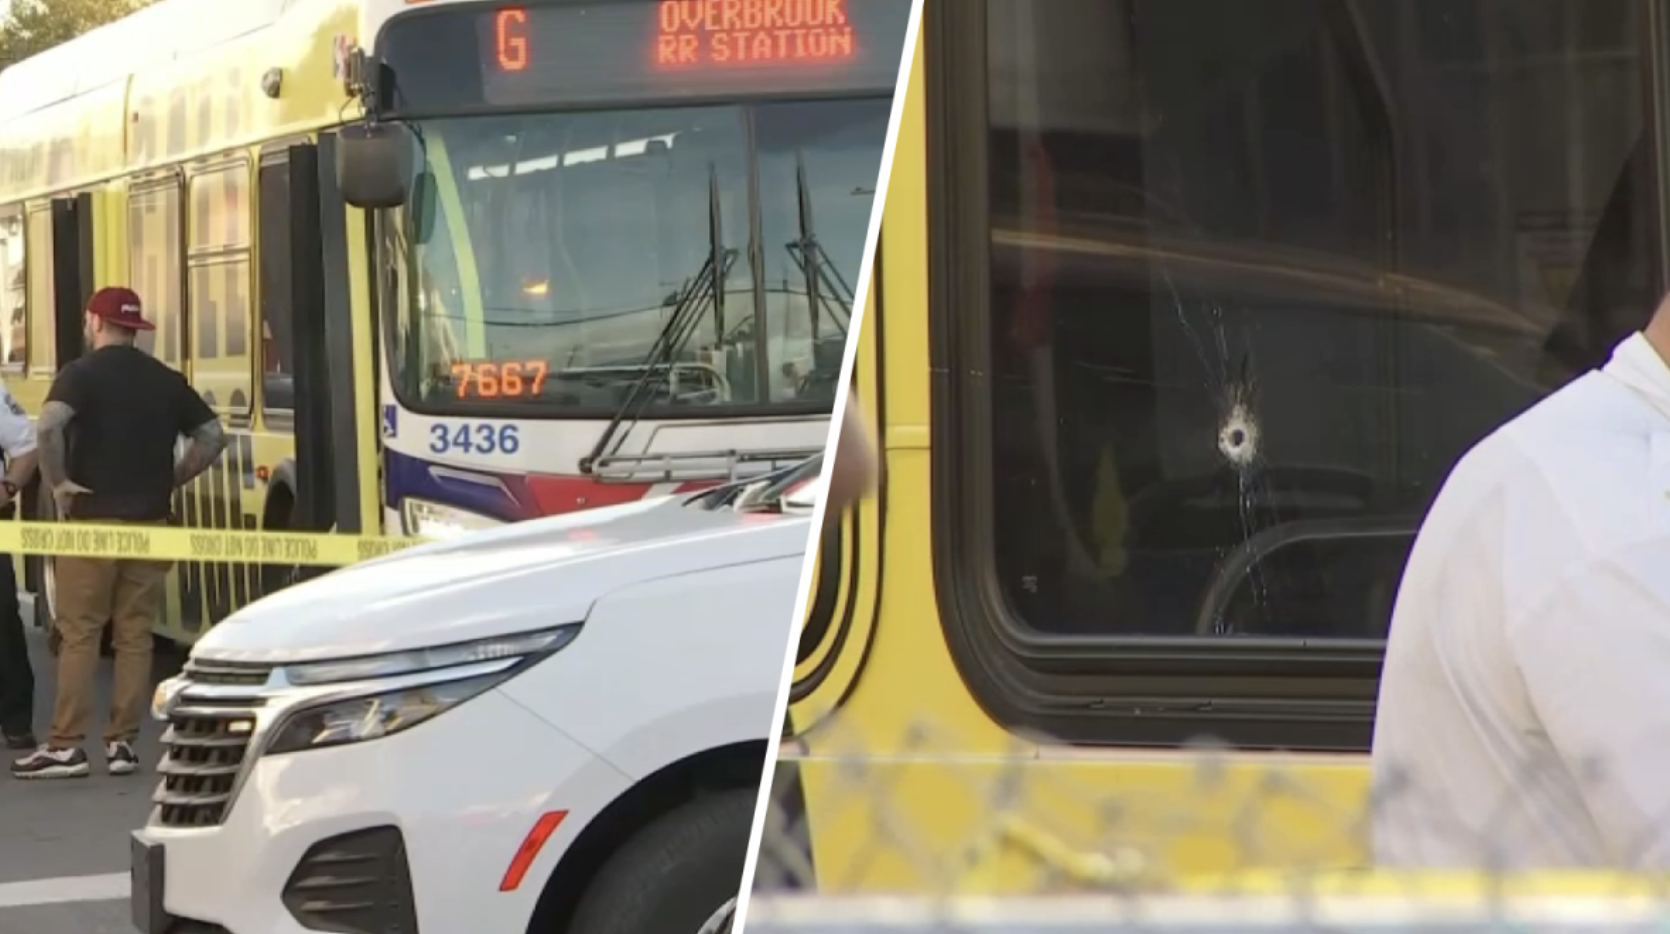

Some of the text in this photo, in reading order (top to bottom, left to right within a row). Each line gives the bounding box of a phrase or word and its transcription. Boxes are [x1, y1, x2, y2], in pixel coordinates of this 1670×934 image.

[661, 0, 846, 32] OVERBROOK
[497, 10, 528, 70] G
[658, 27, 852, 64] RR STATION
[451, 361, 547, 398] 7667
[429, 423, 520, 454] 3436
[21, 527, 150, 554] POLICE LINE DO NOT CROSS
[190, 535, 222, 555] CROSS
[262, 537, 281, 557] LINE
[284, 538, 318, 560] POLICE
